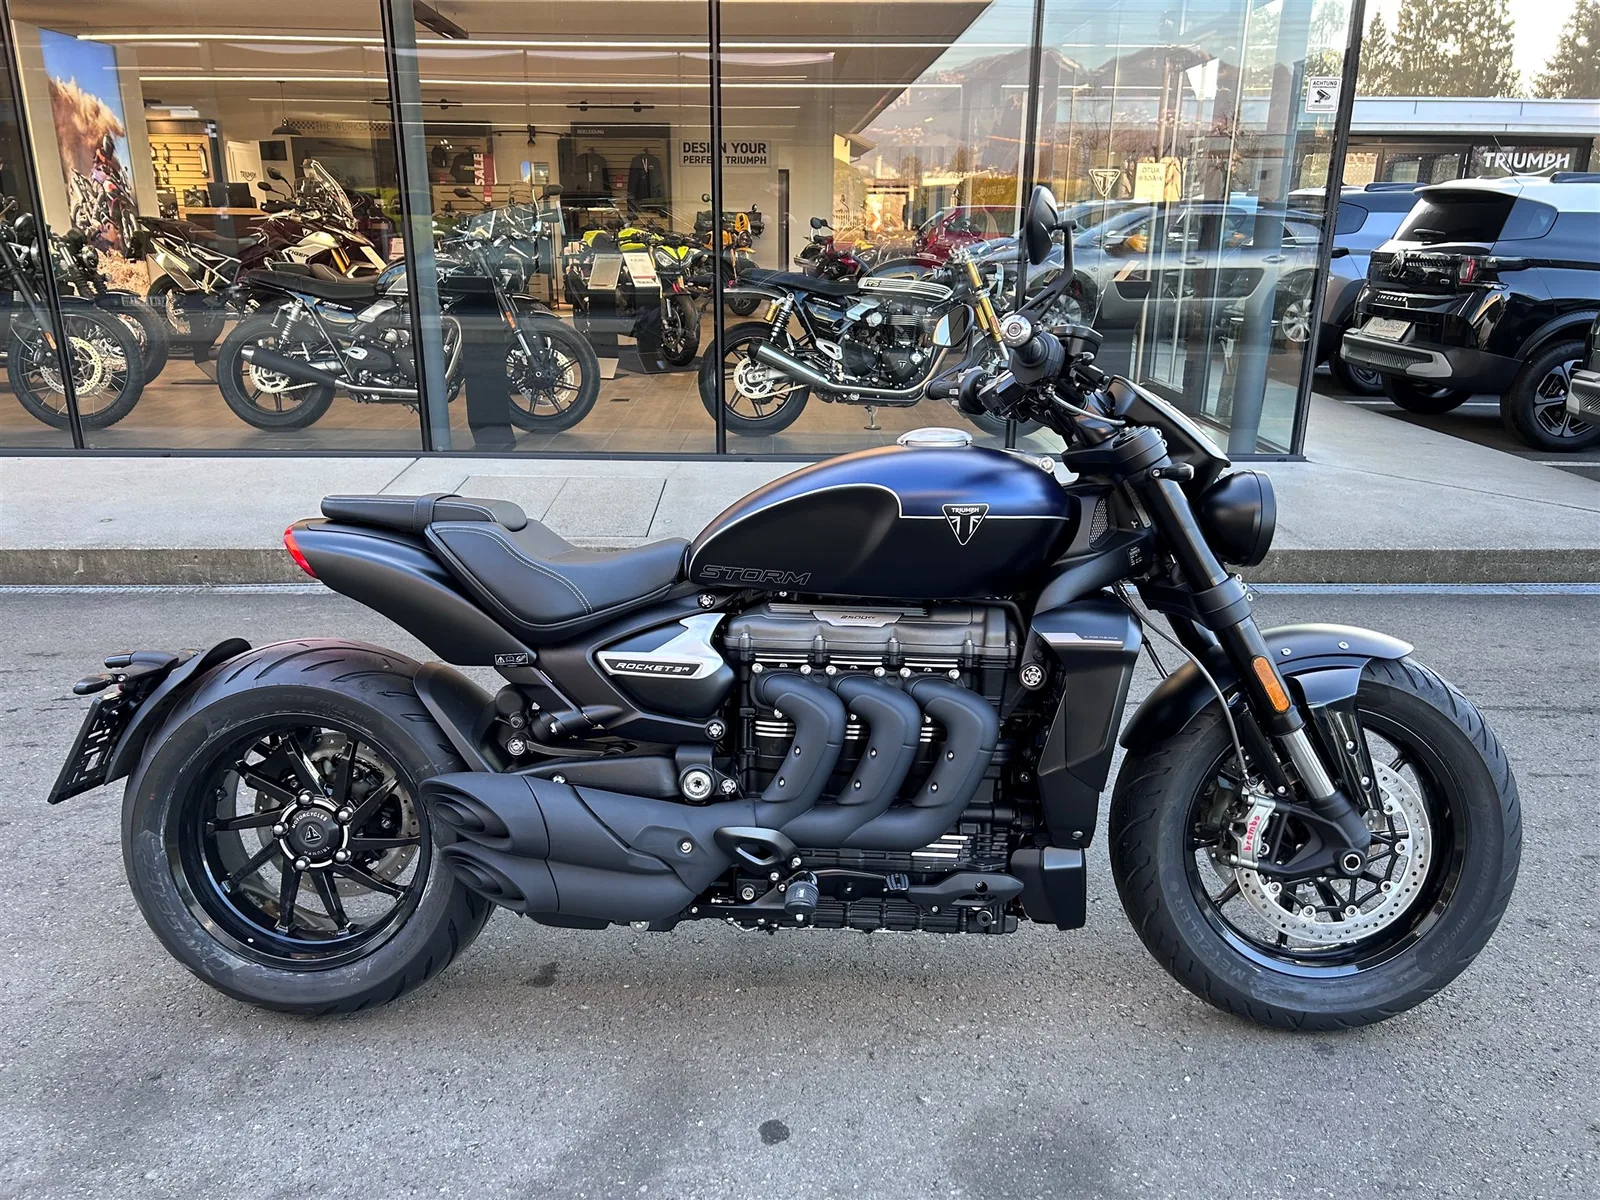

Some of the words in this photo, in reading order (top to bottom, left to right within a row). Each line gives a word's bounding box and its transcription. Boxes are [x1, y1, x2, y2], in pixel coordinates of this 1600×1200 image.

[315, 121, 332, 130] THE
[334, 122, 363, 131] WORKS
[683, 142, 727, 153] DESIN
[731, 142, 767, 154] YOUR
[473, 153, 485, 186] SALE
[725, 156, 767, 164] TRIUMPH
[1483, 152, 1571, 175] TRIUMPH
[951, 507, 980, 515] TRIUMPH
[699, 564, 812, 586] STORM
[291, 811, 328, 829] MOTORCYCLES
[1243, 815, 1261, 852] brembo
[1173, 897, 1246, 981] METZELER
